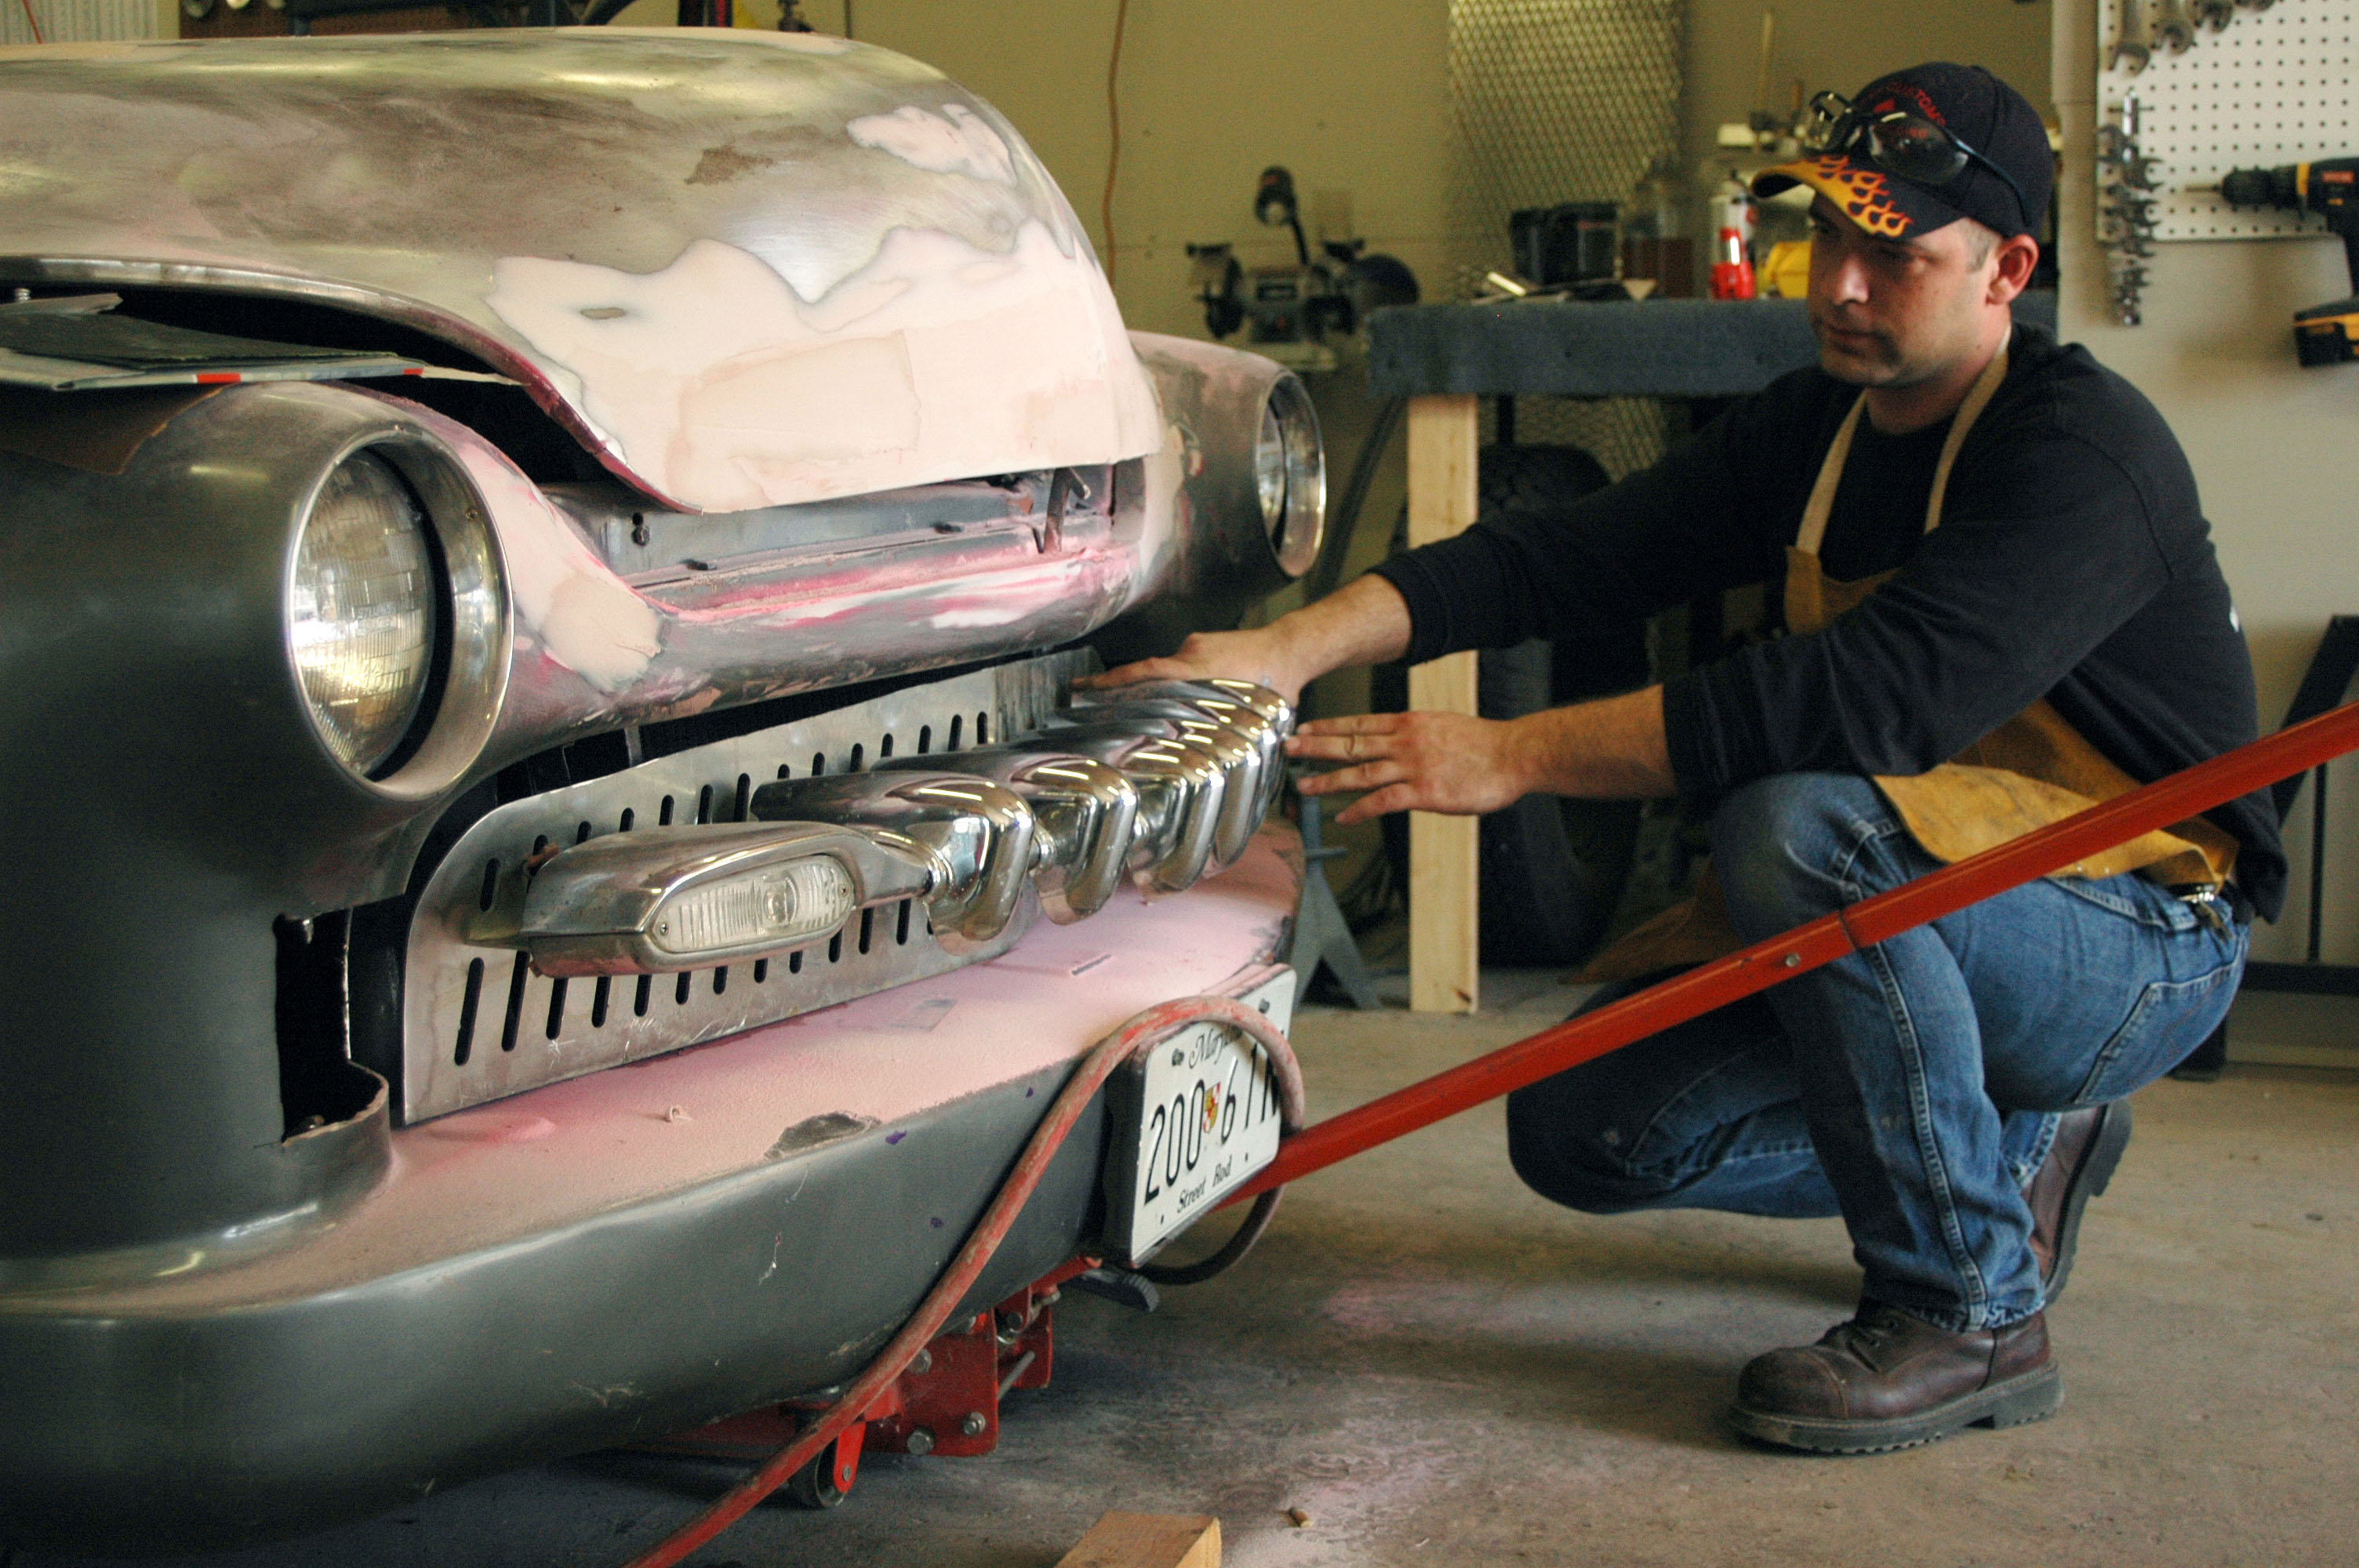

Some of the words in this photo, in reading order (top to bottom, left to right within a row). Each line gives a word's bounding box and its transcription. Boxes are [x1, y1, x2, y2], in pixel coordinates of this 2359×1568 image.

[1144, 1078, 1205, 1207] 200
[1177, 1177, 1206, 1214] Street
[1212, 1155, 1232, 1187] Rod
